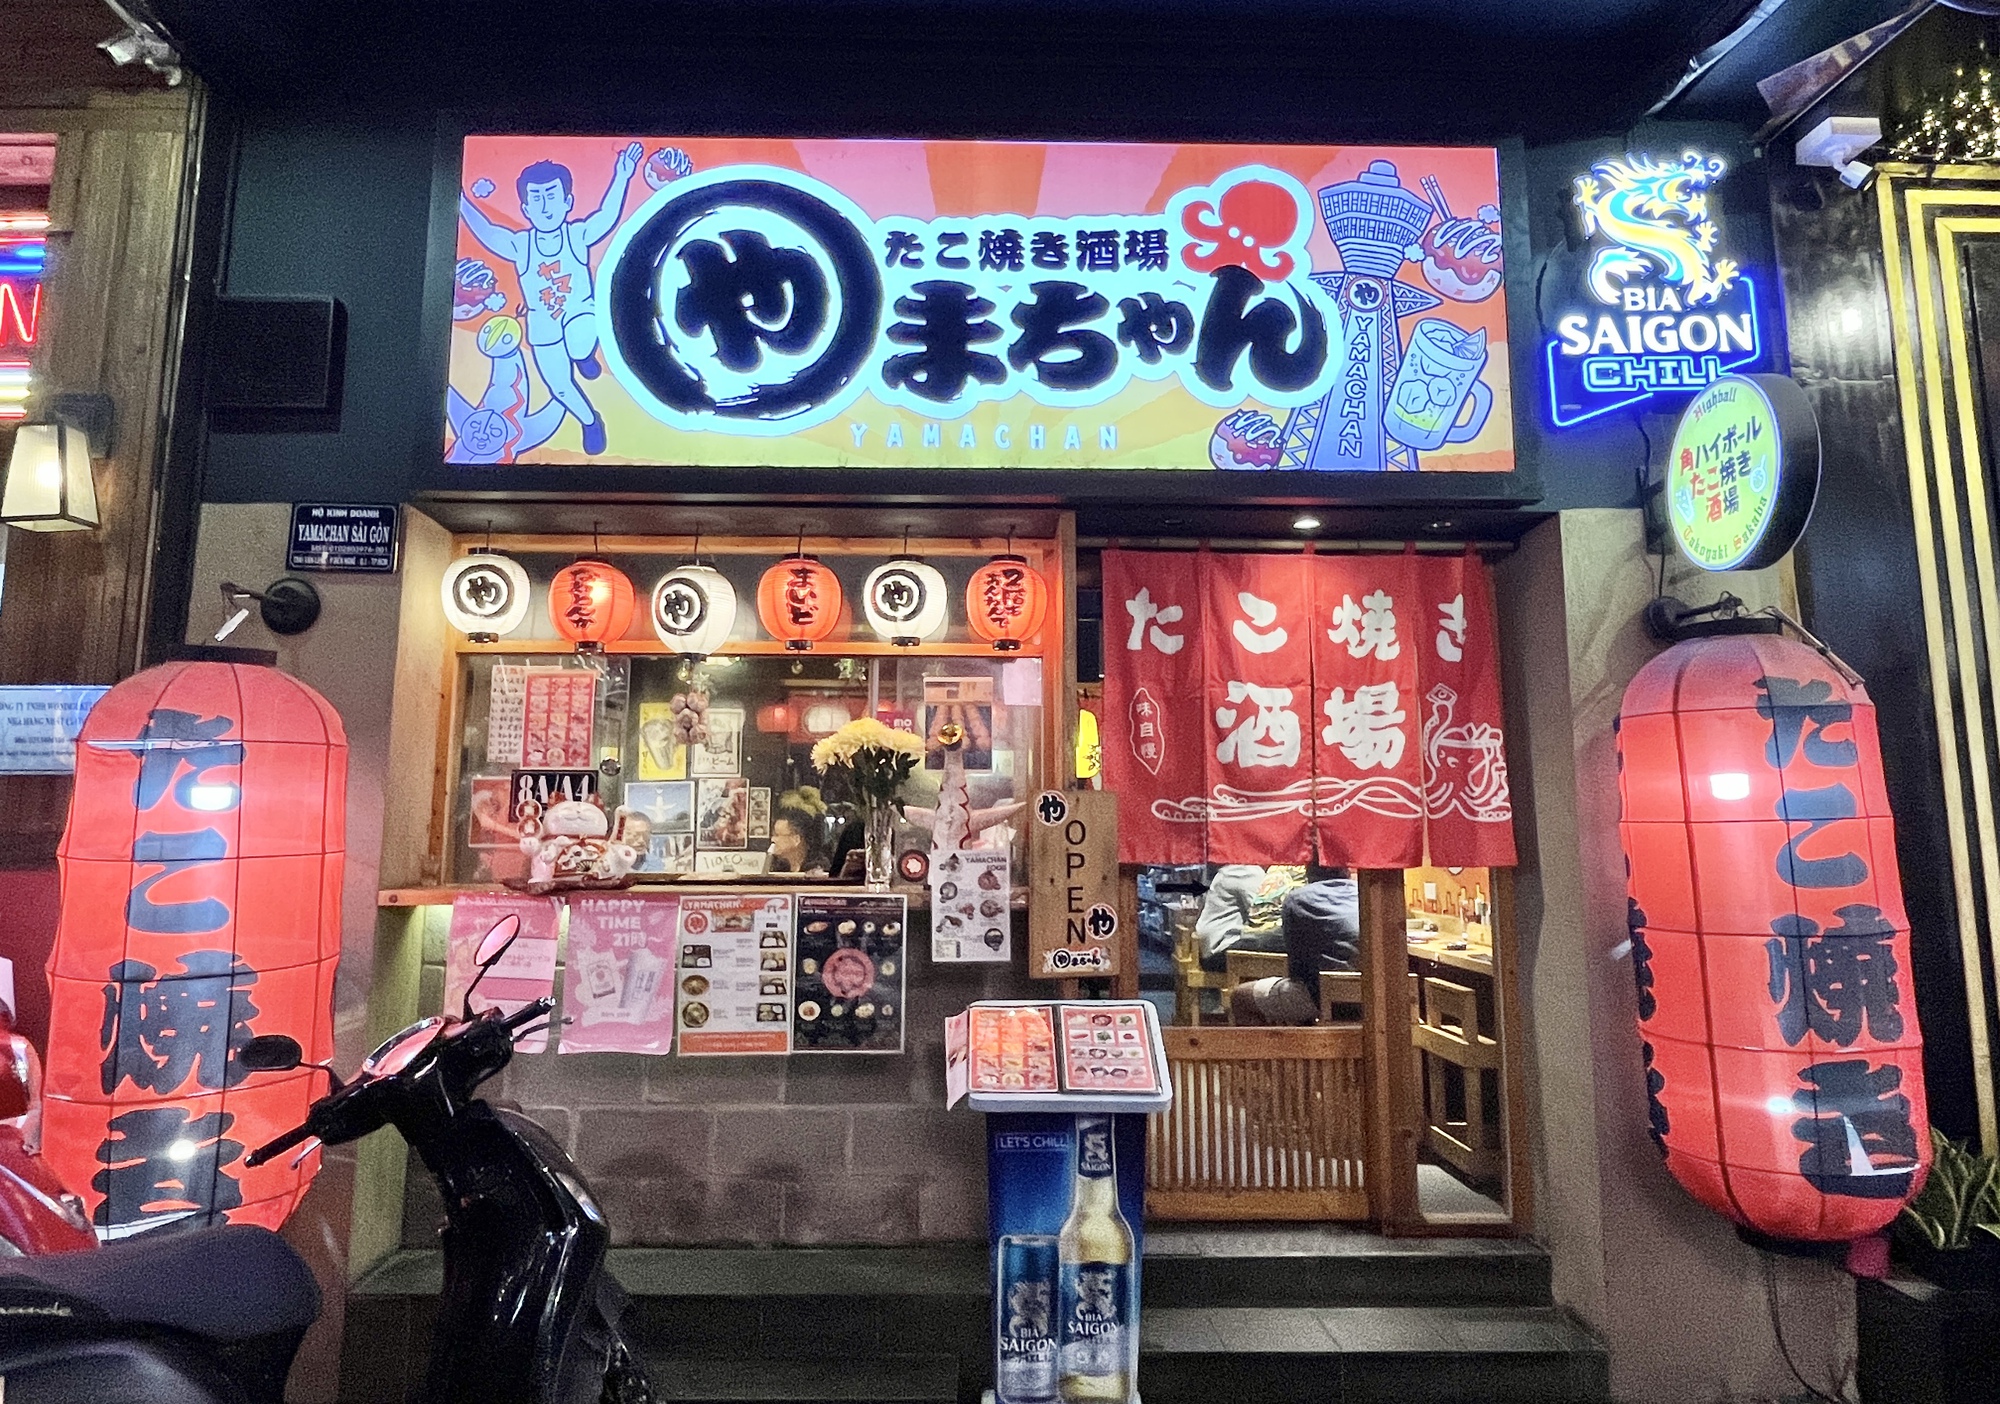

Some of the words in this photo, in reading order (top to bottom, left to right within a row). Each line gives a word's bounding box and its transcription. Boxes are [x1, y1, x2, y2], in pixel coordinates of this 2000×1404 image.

[885, 229, 1169, 272] たこ焼き酒場
[1623, 287, 1683, 312] BIA
[1559, 313, 1753, 355] SAIGON
[1336, 315, 1369, 459] YAMACHAN
[851, 422, 1119, 451] YAMACHAN
[1680, 416, 1762, 475] 角ハイボール
[1689, 450, 1752, 499] たこ焼き
[1706, 485, 1740, 523] 酒場
[298, 524, 350, 542] YAMACHAN
[466, 576, 500, 609] や
[664, 589, 697, 625] や
[881, 580, 915, 612] や
[1126, 586, 1469, 663] たこ焼き
[1215, 681, 1406, 770] 酒場
[1038, 795, 1066, 823] や
[1065, 819, 1087, 945] OPEN
[581, 898, 646, 913] HAPPY
[598, 915, 642, 930] TIME
[1088, 907, 1116, 937] や
[1000, 1135, 1031, 1149] LET'S
[1032, 1136, 1068, 1149] CHILL
[1080, 1161, 1112, 1171] SAIGON
[1067, 1320, 1119, 1335] SAIGON
[1084, 1312, 1103, 1322] BIA
[1000, 1337, 1057, 1352] SAIGON
[1020, 1327, 1040, 1338] BIA
